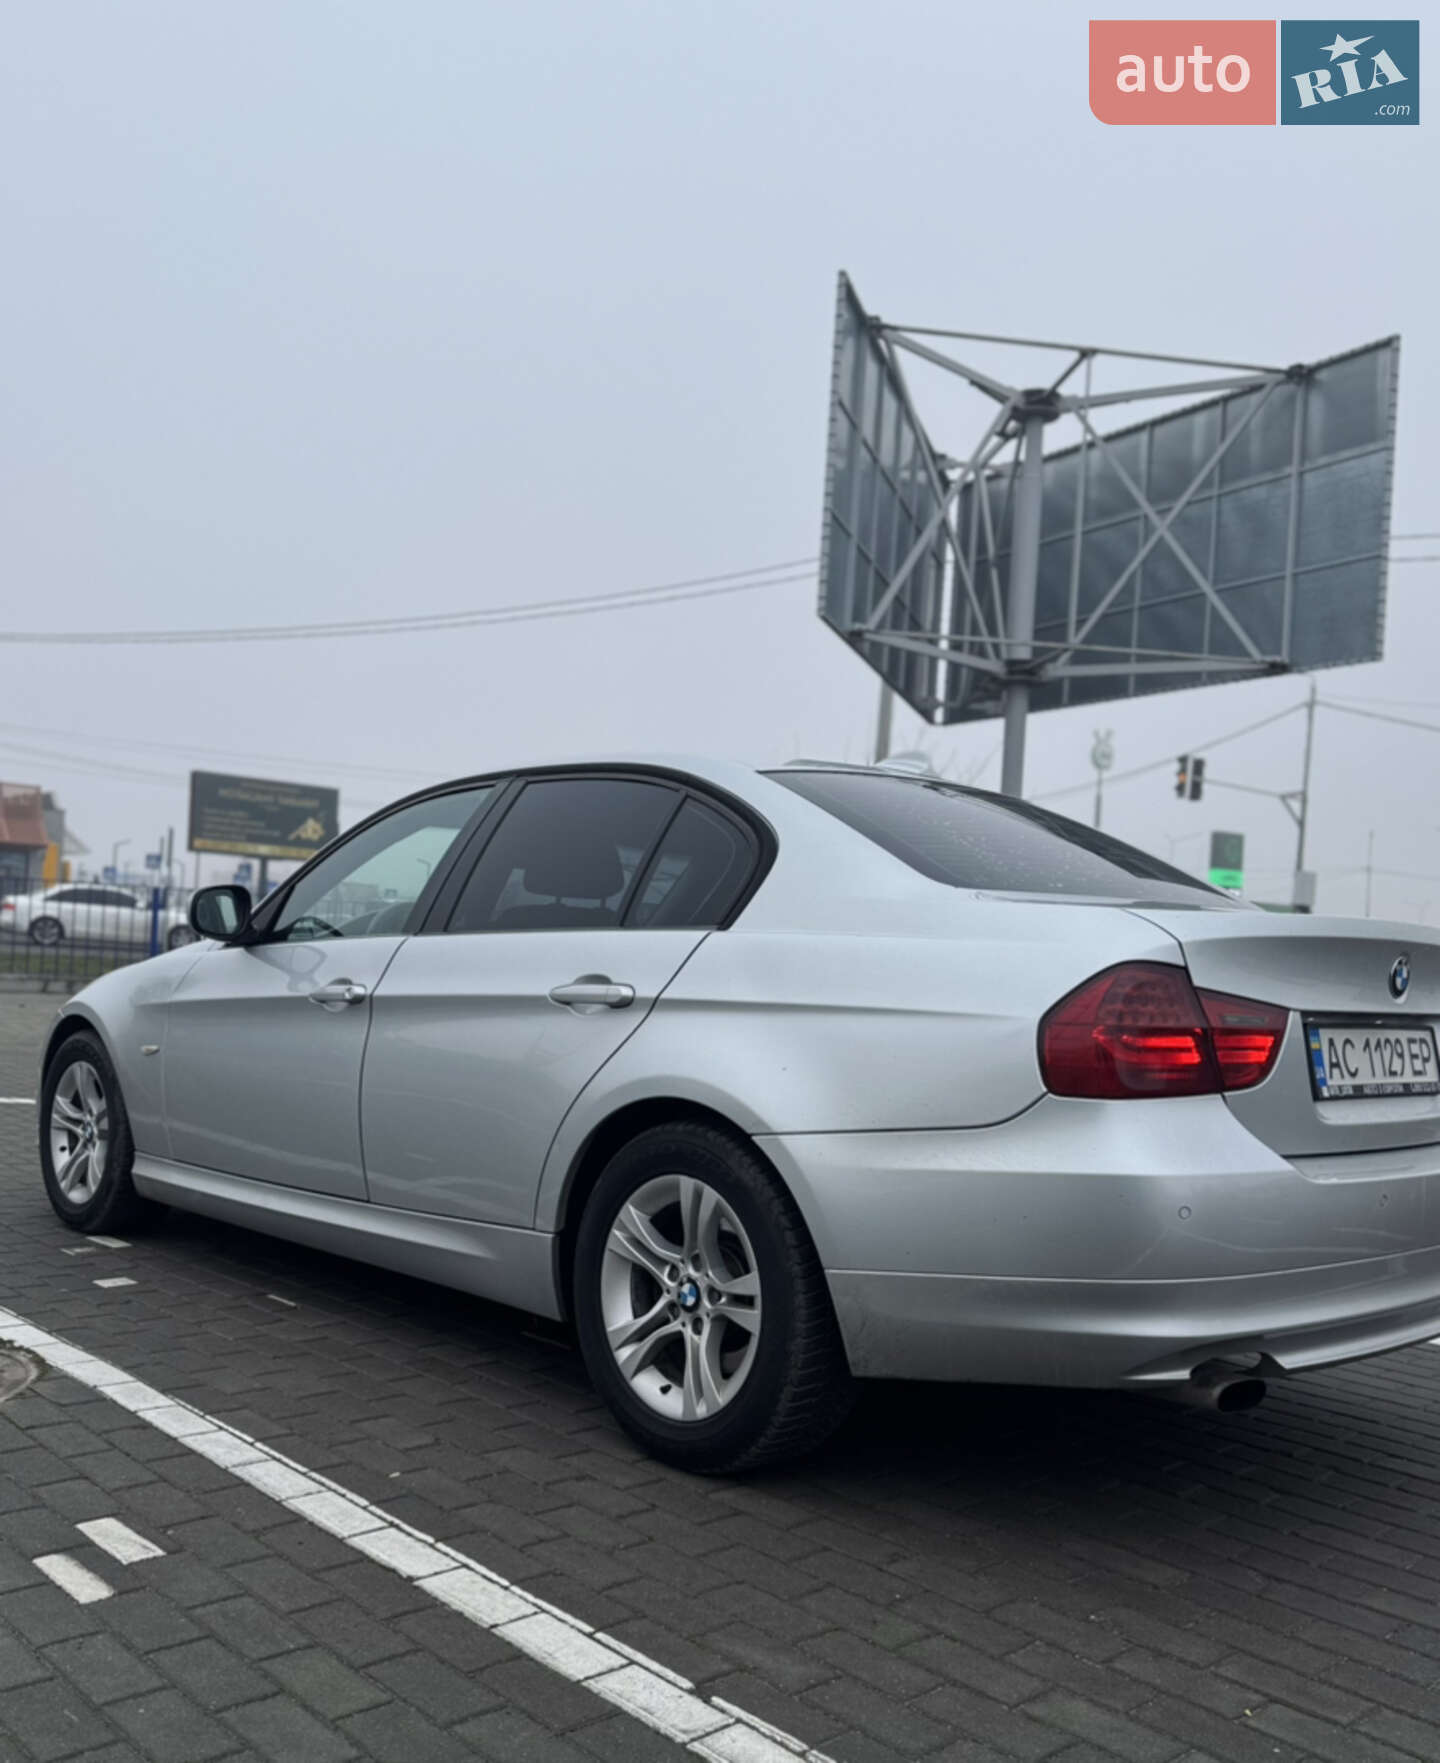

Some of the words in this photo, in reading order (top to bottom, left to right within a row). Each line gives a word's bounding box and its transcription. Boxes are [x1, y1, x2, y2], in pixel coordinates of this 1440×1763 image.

[1328, 1037, 1359, 1079] AC
[1363, 1037, 1405, 1078] 1129
[1407, 1037, 1431, 1076] EP
